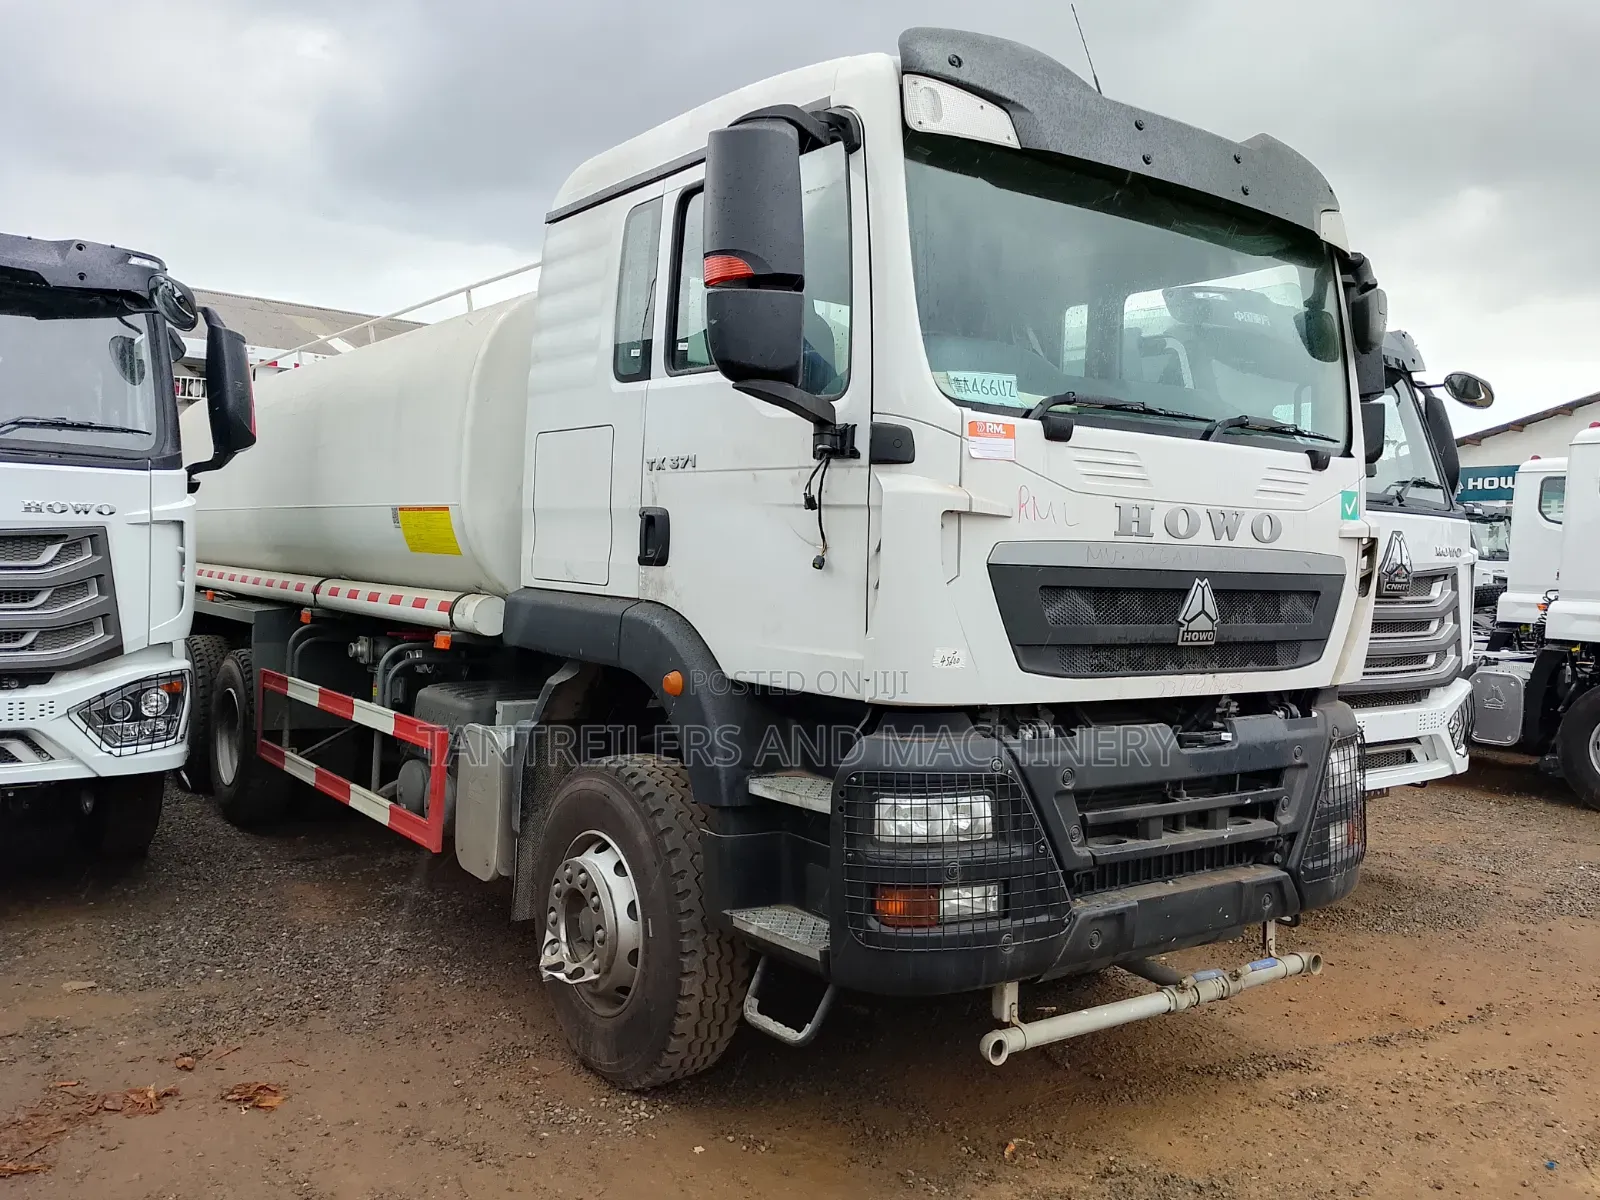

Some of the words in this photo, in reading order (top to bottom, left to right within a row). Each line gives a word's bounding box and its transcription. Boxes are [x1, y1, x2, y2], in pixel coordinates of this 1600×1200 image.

[646, 456, 666, 471] TX
[669, 454, 697, 470] 371
[21, 499, 117, 516] HOWO
[1114, 502, 1283, 544] HOWO
[1182, 631, 1214, 642] HOWO
